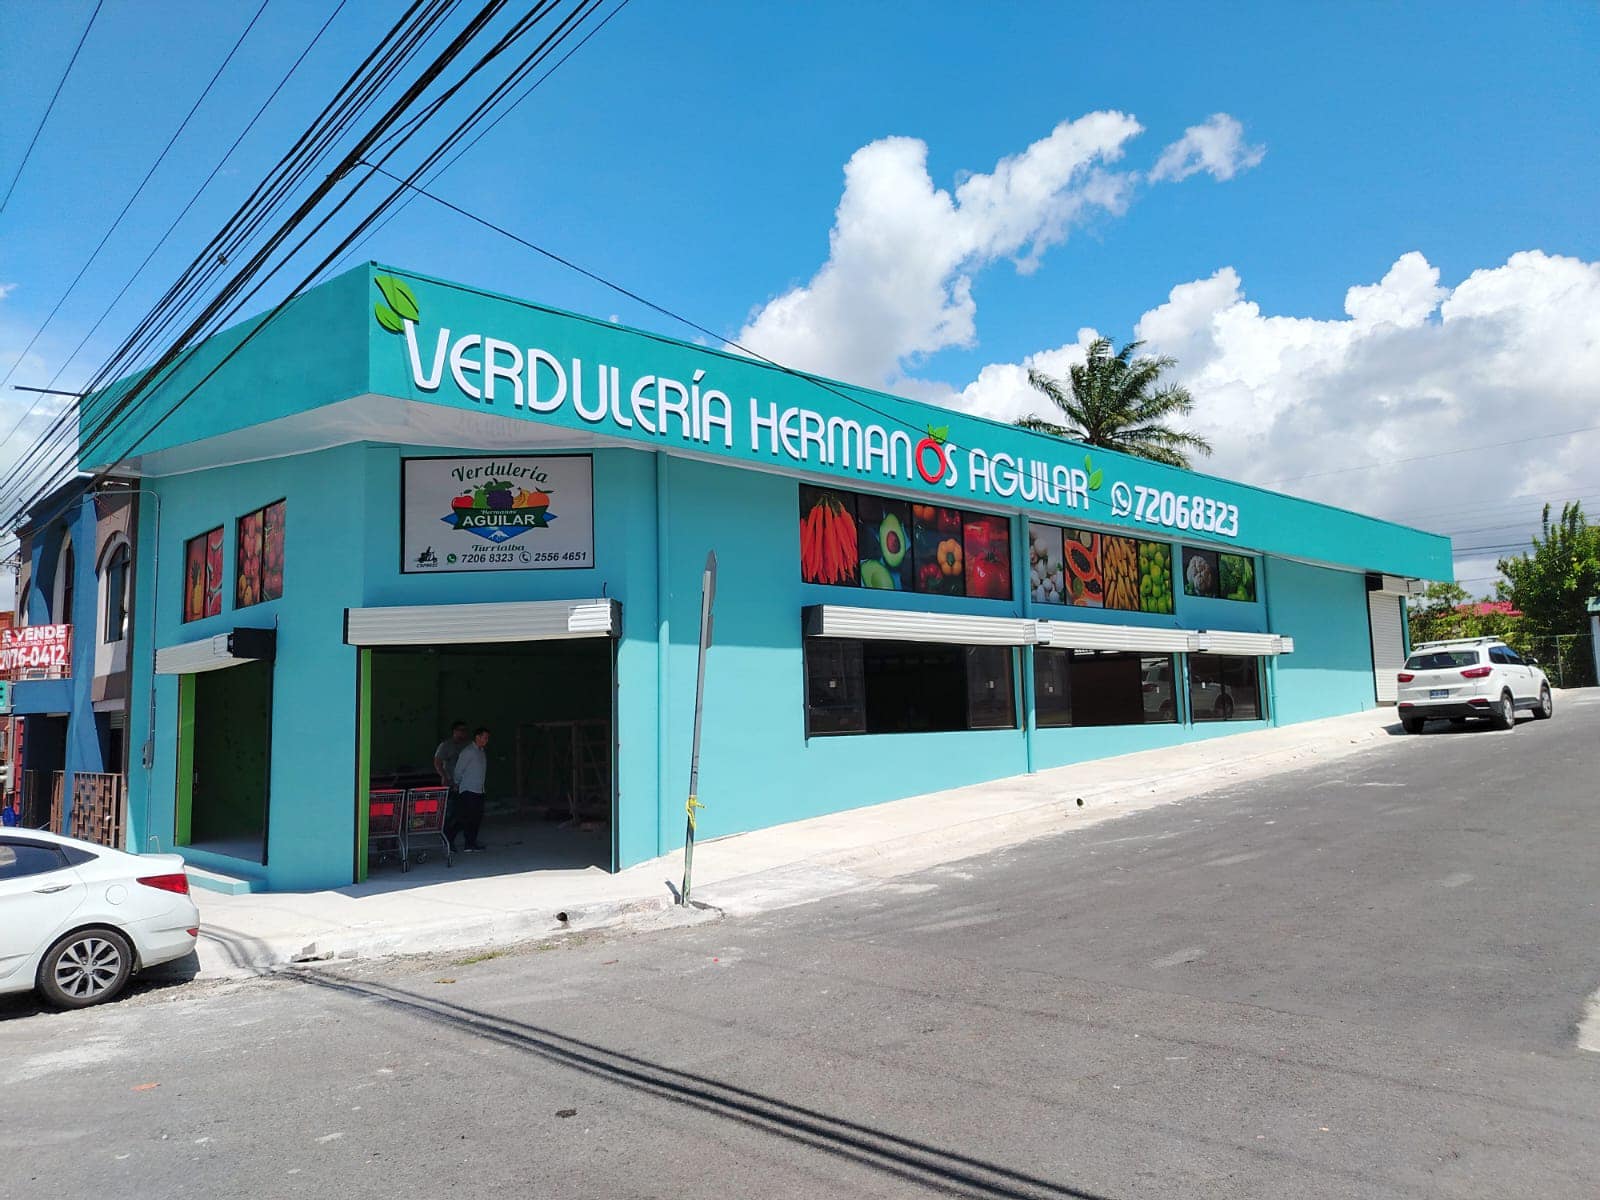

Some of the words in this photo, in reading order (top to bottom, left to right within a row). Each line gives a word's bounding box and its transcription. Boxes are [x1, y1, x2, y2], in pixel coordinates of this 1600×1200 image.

[403, 319, 732, 447] VERDULERÍA
[750, 397, 958, 487] HERMANOS
[968, 447, 1089, 510] AGUILAR
[1134, 485, 1239, 537] 72068323
[451, 462, 548, 483] Verdulería
[462, 514, 536, 527] AGUILAR
[471, 543, 525, 552] Turrialba
[461, 553, 486, 563] 7206
[488, 553, 514, 563] 8323
[534, 552, 559, 562] 2556
[562, 551, 587, 561] 4651
[14, 624, 66, 642] VENDE
